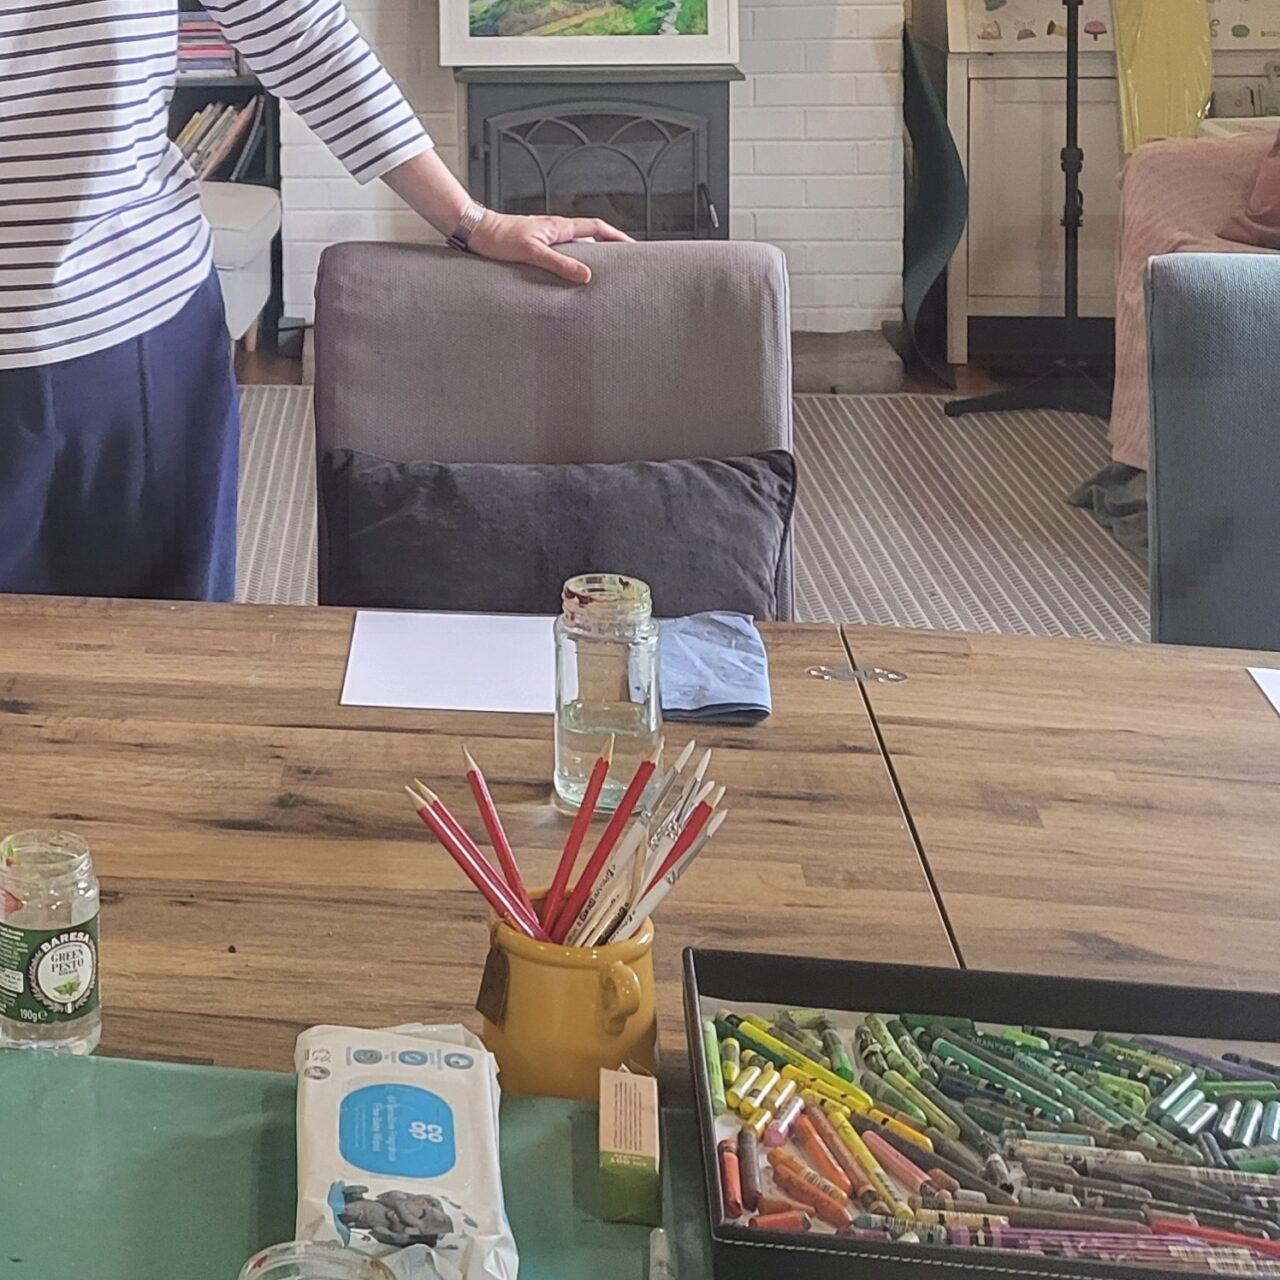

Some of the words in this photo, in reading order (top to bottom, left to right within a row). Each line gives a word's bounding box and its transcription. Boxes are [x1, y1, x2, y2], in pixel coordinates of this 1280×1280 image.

[40, 931, 90, 953] BARESA
[50, 948, 84, 963] GREEN
[51, 957, 84, 973] PESTO
